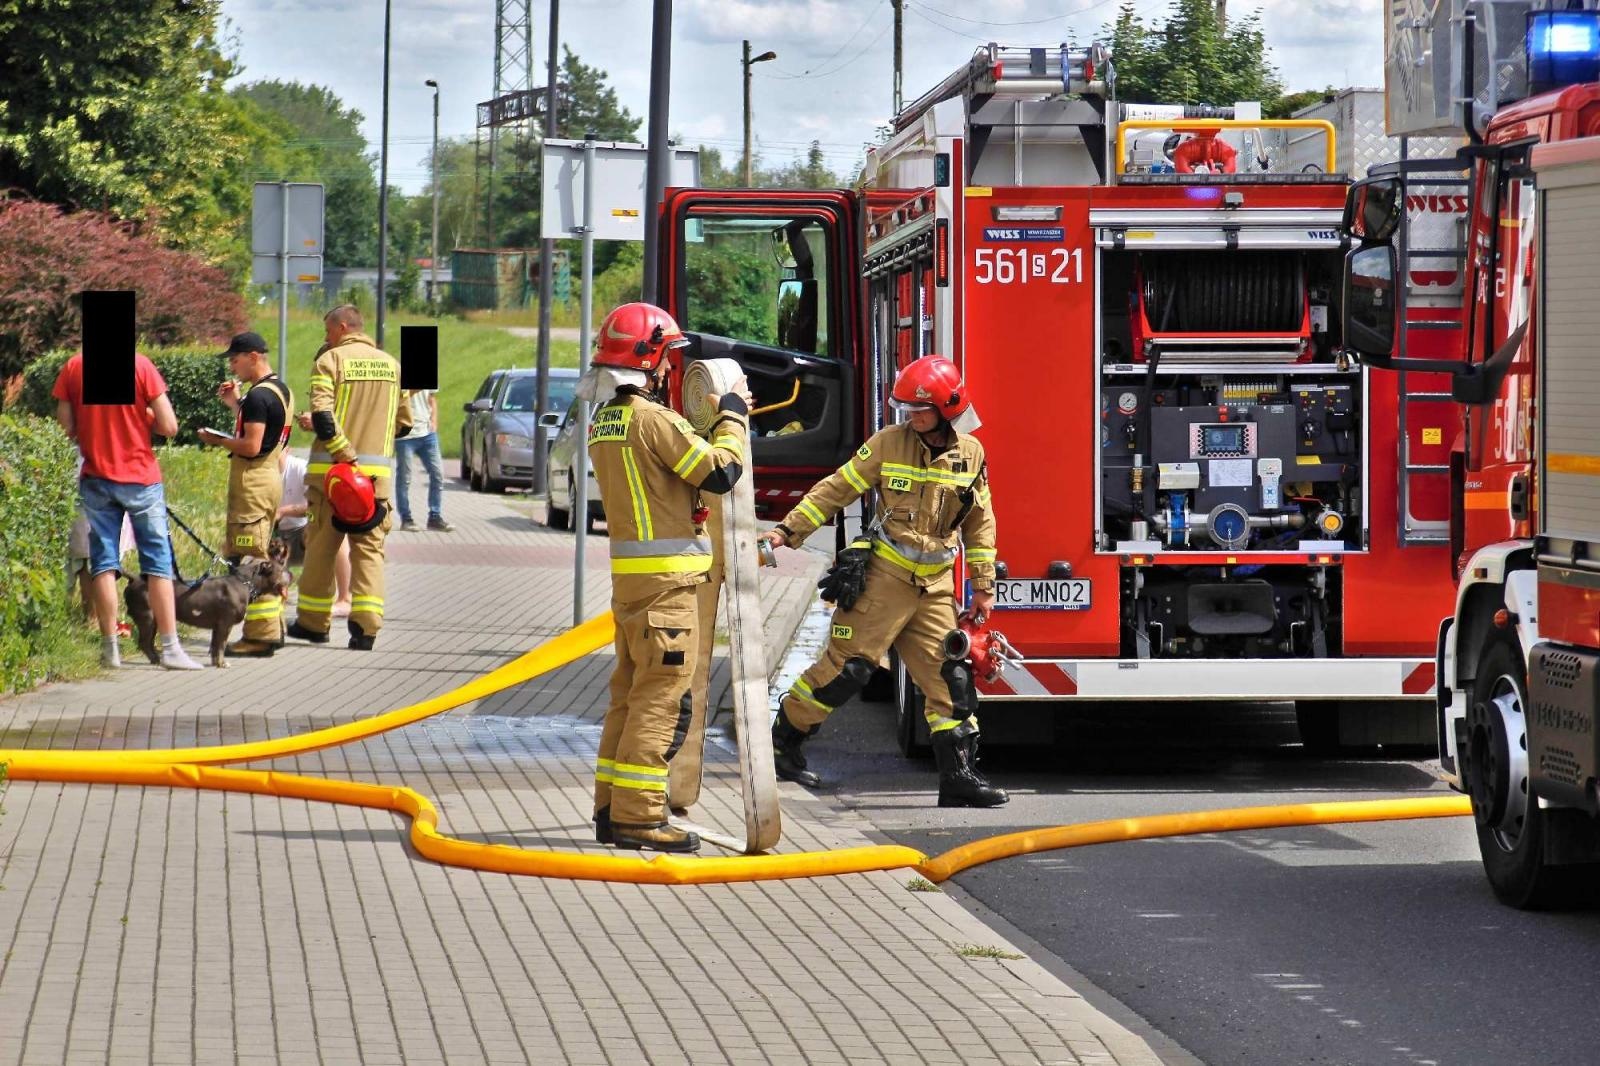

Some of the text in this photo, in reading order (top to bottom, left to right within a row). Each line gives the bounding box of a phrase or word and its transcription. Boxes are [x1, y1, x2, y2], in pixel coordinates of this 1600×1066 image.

[1407, 195, 1468, 212] WISS
[986, 229, 1020, 239] WISS
[1307, 231, 1336, 239] WISS
[975, 248, 1027, 283] 561
[1051, 248, 1082, 283] 21
[891, 478, 909, 488] PSP
[996, 582, 1084, 602] RC MN02
[834, 626, 850, 637] PSP
